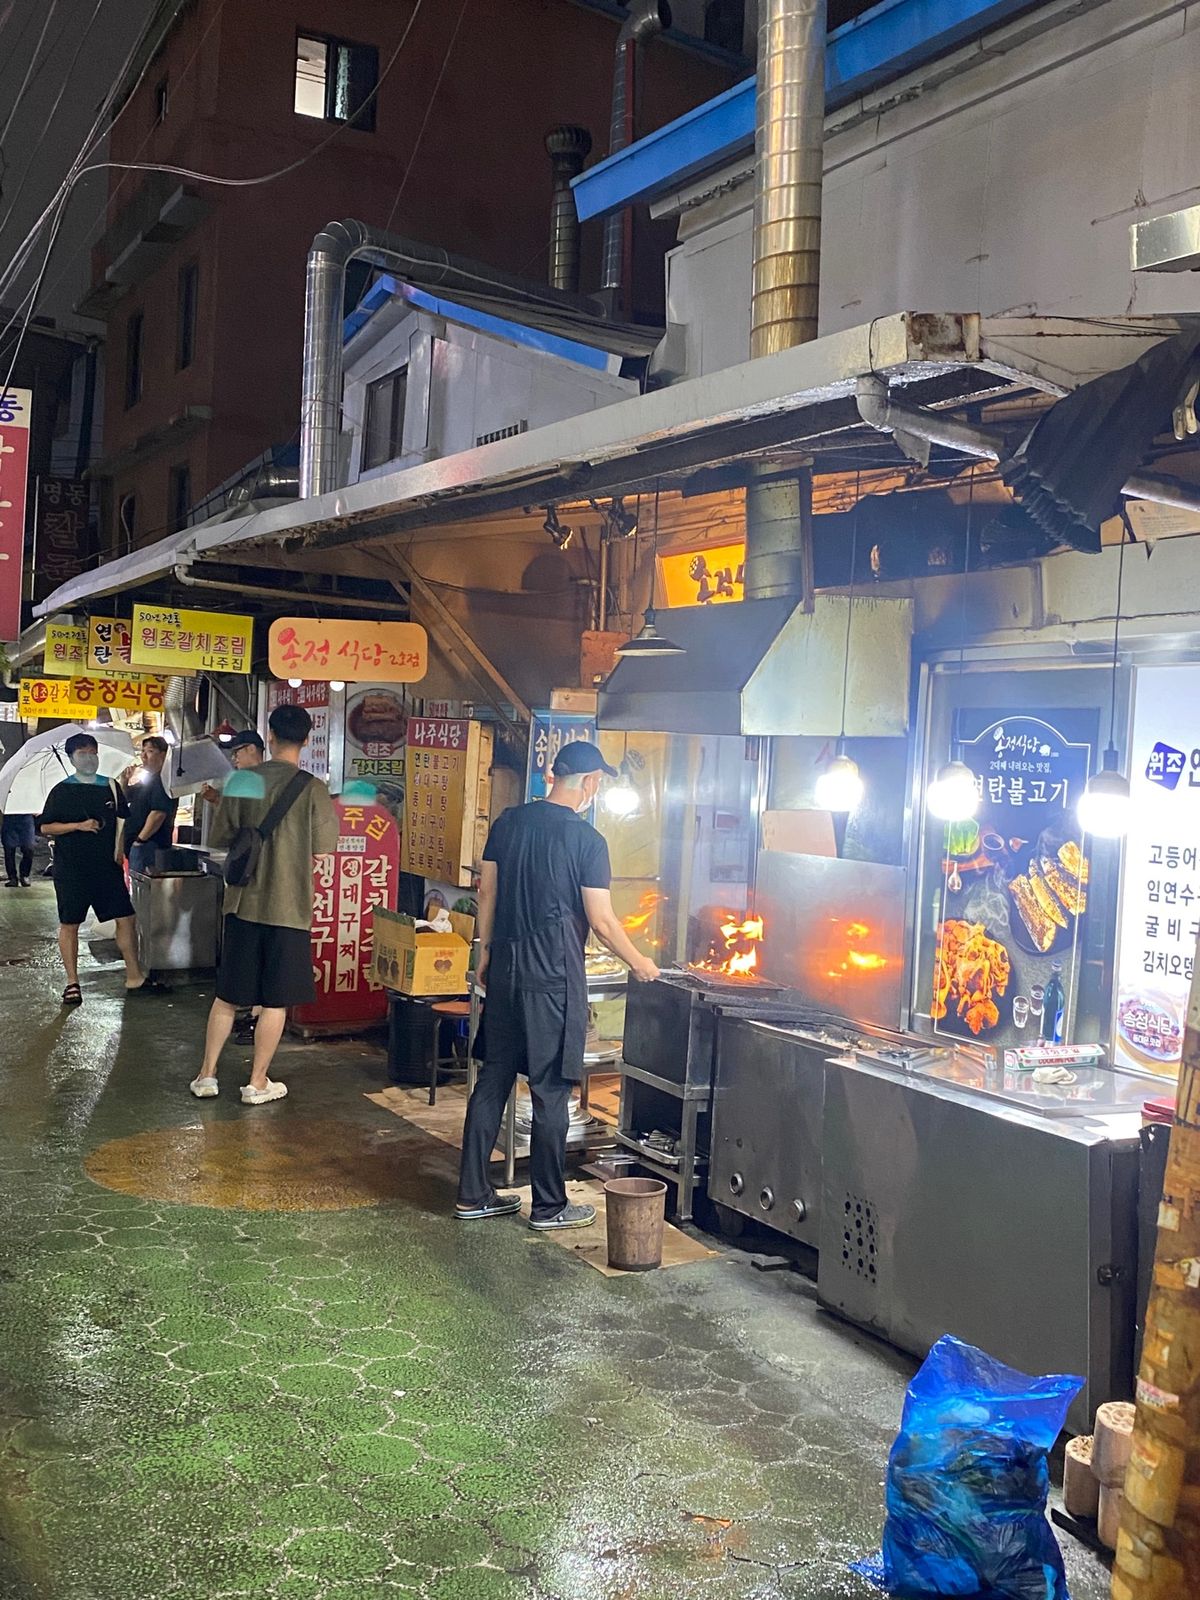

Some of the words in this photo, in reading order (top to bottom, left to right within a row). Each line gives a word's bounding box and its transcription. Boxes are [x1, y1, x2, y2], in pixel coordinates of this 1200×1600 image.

[54, 643, 88, 661] 원조
[142, 626, 246, 657] 원조갈치조림
[277, 627, 330, 669] 송정
[337, 640, 388, 670] 식당
[389, 651, 420, 668] 2호점
[202, 655, 243, 671] 나주집
[74, 677, 165, 708] 송정식당
[414, 722, 462, 748] 나주식당
[993, 726, 1040, 758] 송정식당
[367, 742, 391, 756] 원조
[352, 759, 405, 776] 갈치조림
[414, 752, 460, 773] 연탄불고기
[1008, 760, 1035, 773] 내려오는
[1149, 751, 1182, 780] 원조
[1148, 844, 1200, 871] 고등어
[1146, 879, 1200, 907] 임연수
[1123, 1010, 1172, 1036] 송정식당
